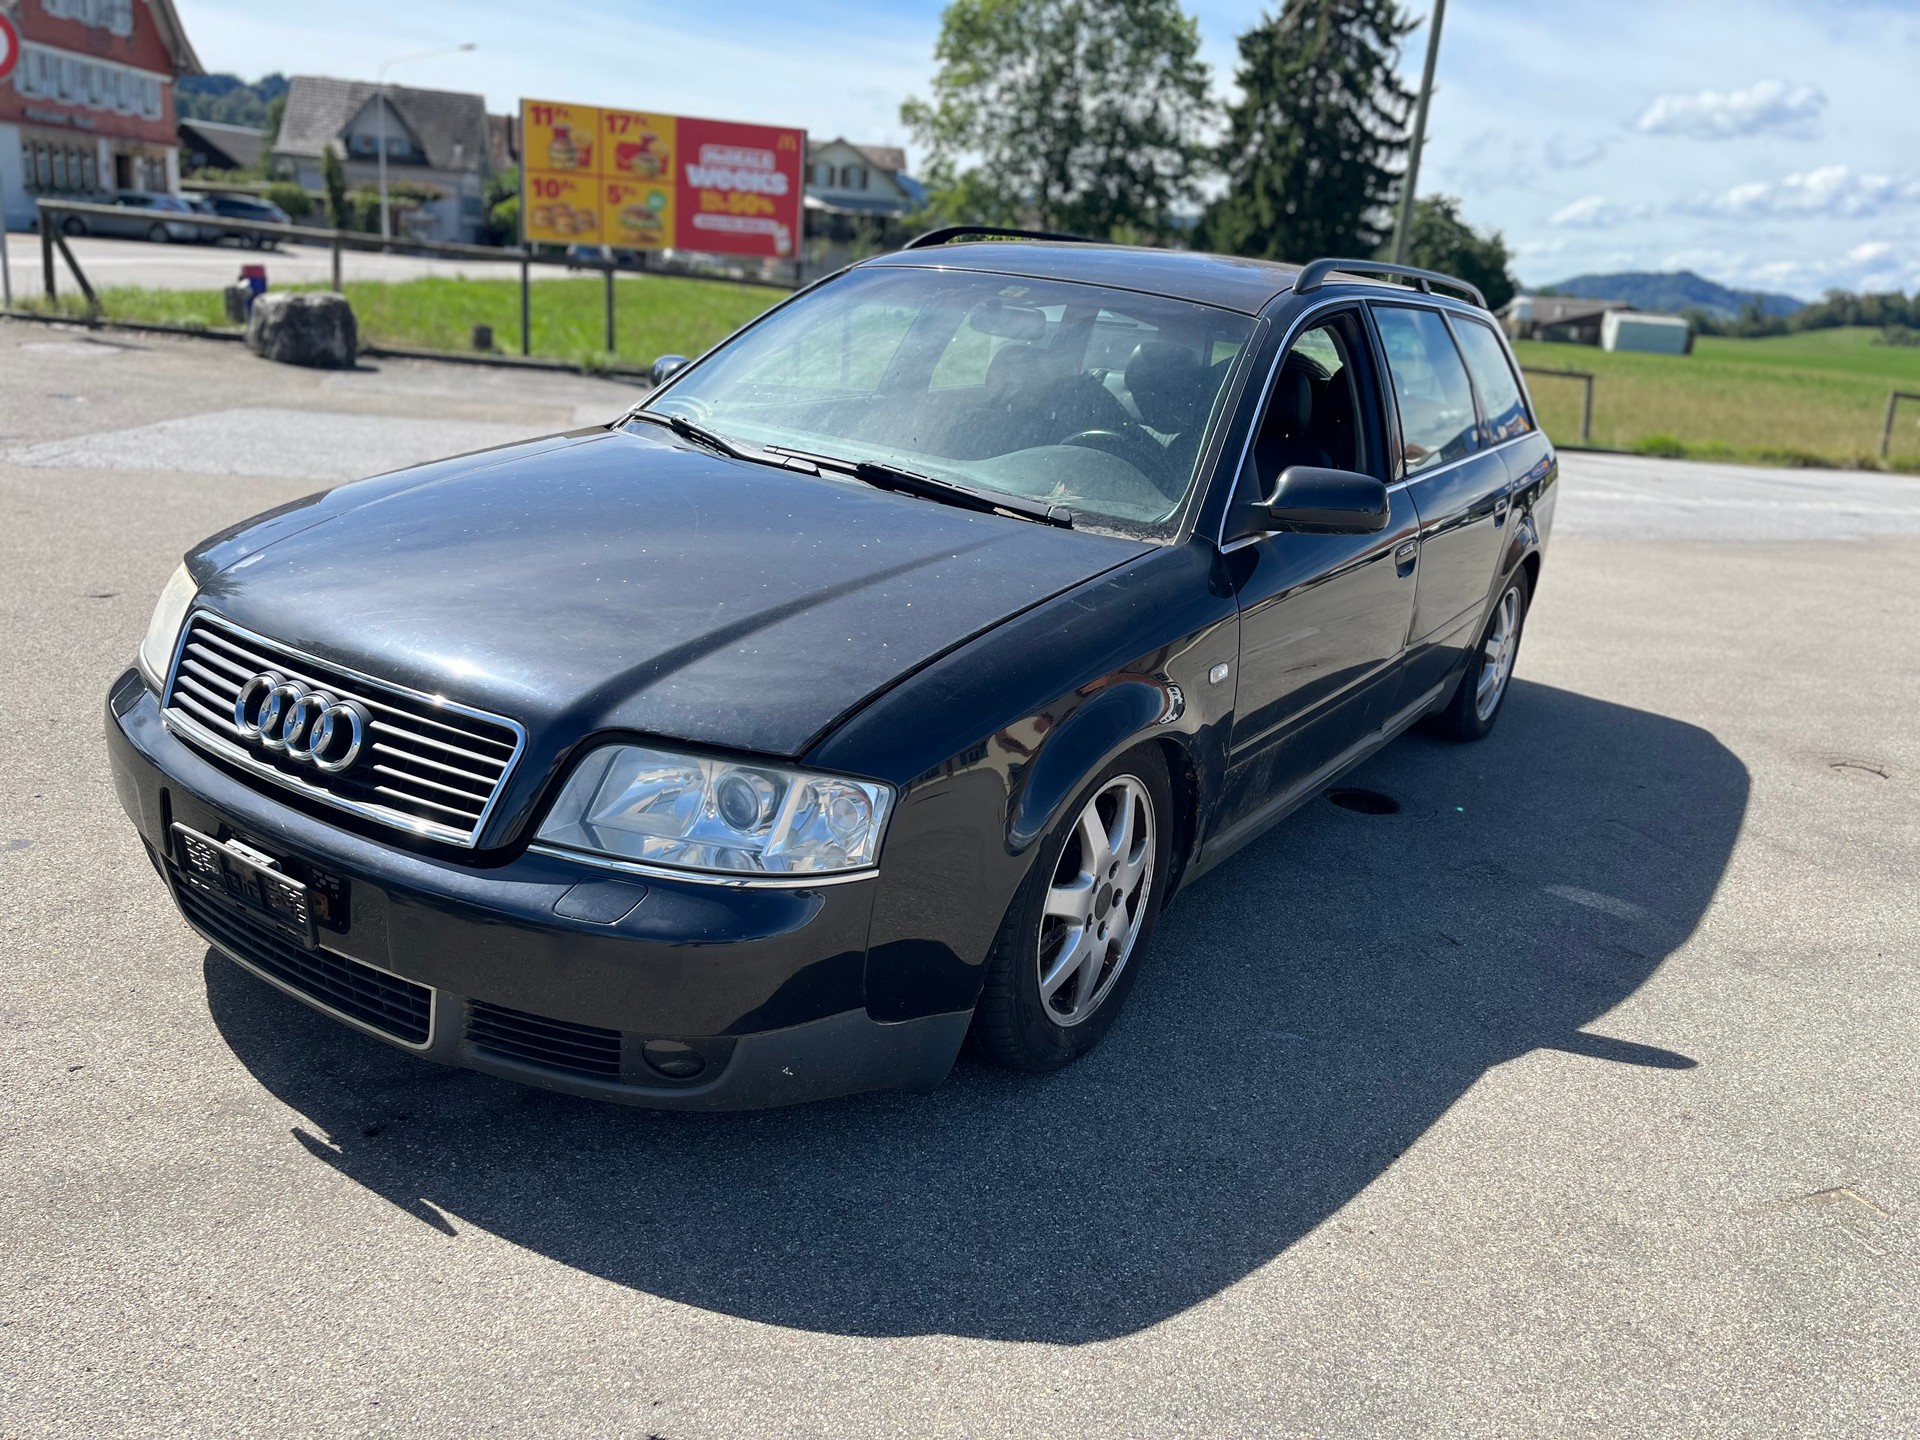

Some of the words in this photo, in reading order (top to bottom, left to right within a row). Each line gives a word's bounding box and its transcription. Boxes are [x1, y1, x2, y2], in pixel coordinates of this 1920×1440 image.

[531, 104, 554, 127] 11
[606, 113, 633, 134] 17
[532, 178, 561, 199] 10
[607, 183, 623, 206] 5
